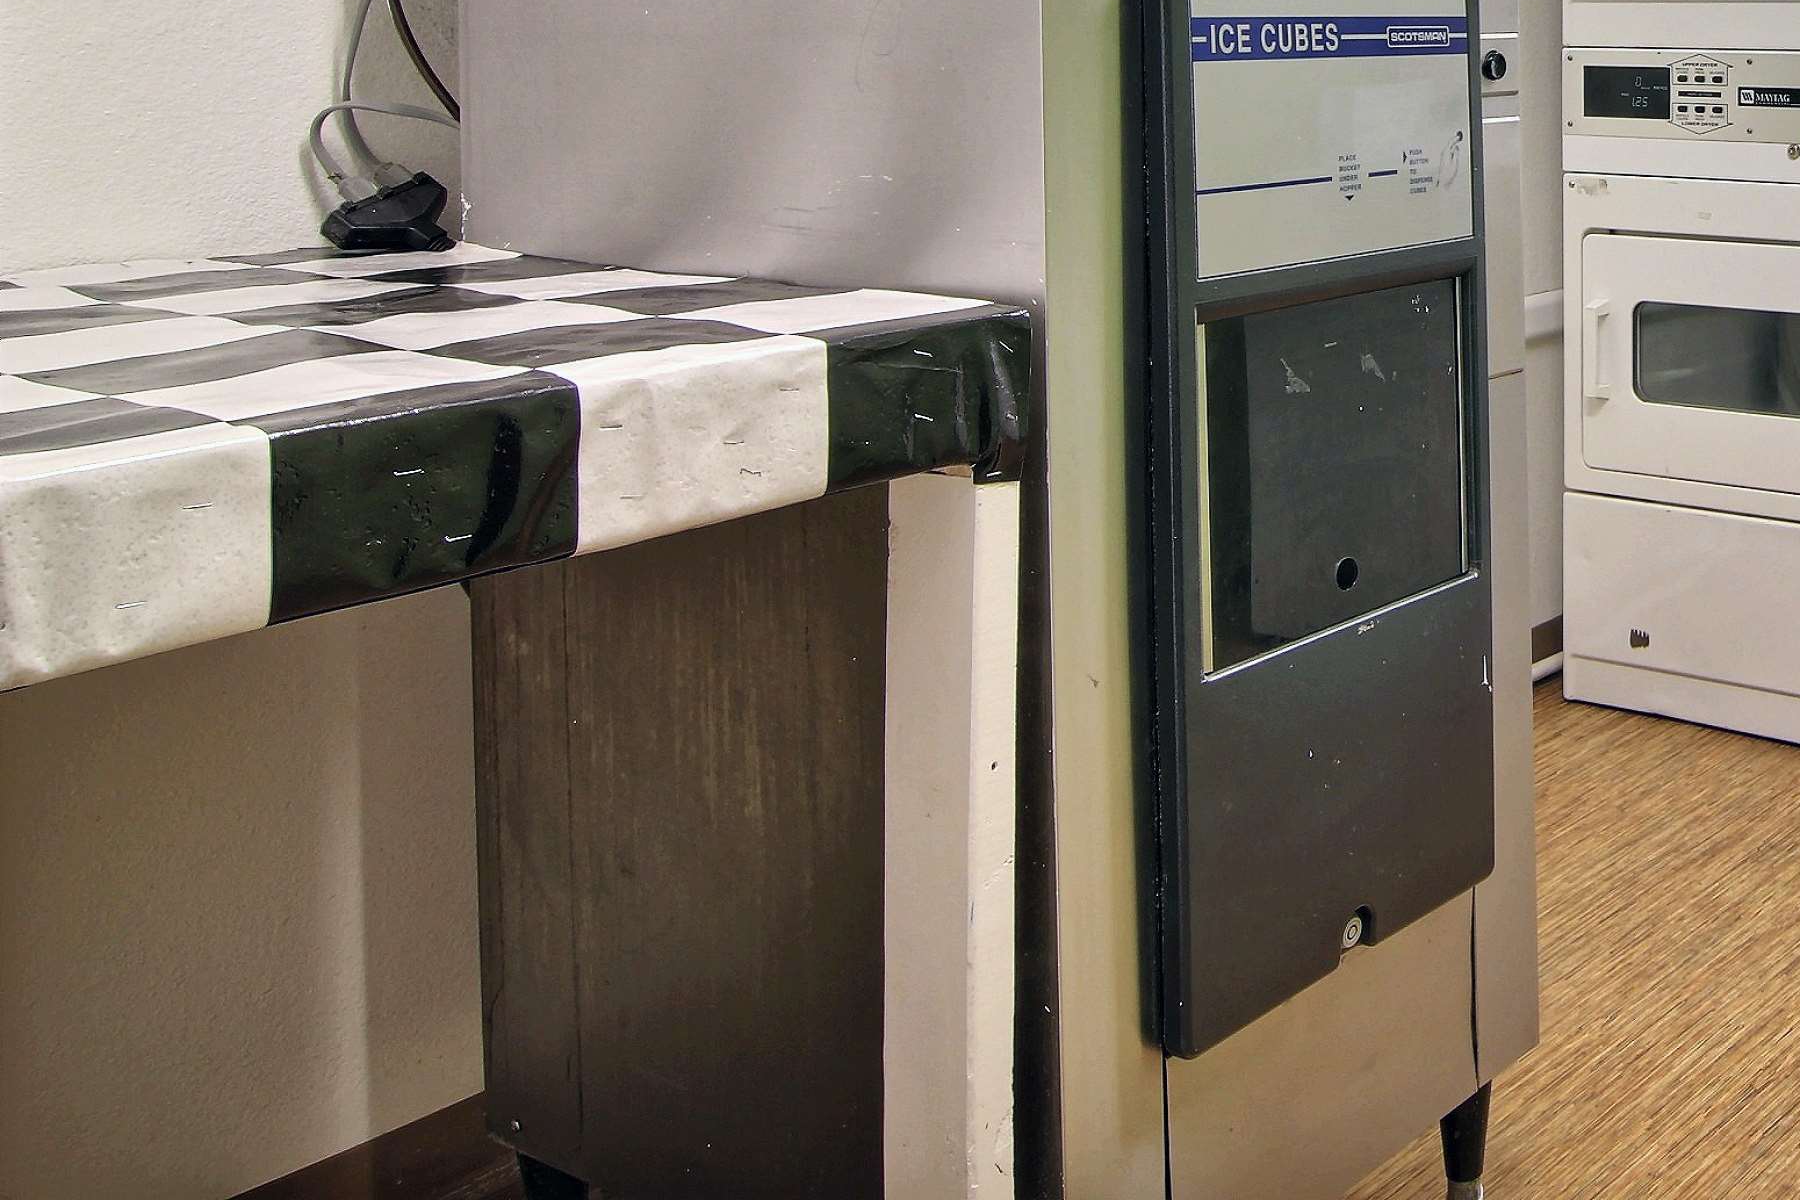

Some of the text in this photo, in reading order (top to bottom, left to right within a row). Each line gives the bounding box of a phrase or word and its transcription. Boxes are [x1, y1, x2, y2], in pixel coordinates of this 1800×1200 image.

[1210, 22, 1340, 54] ICE CUBES
[1390, 30, 1447, 44] SCOTSMAN
[1755, 93, 1790, 103] MAYTAG
[1338, 154, 1356, 162] PLACE
[1338, 164, 1361, 172] BUCKET
